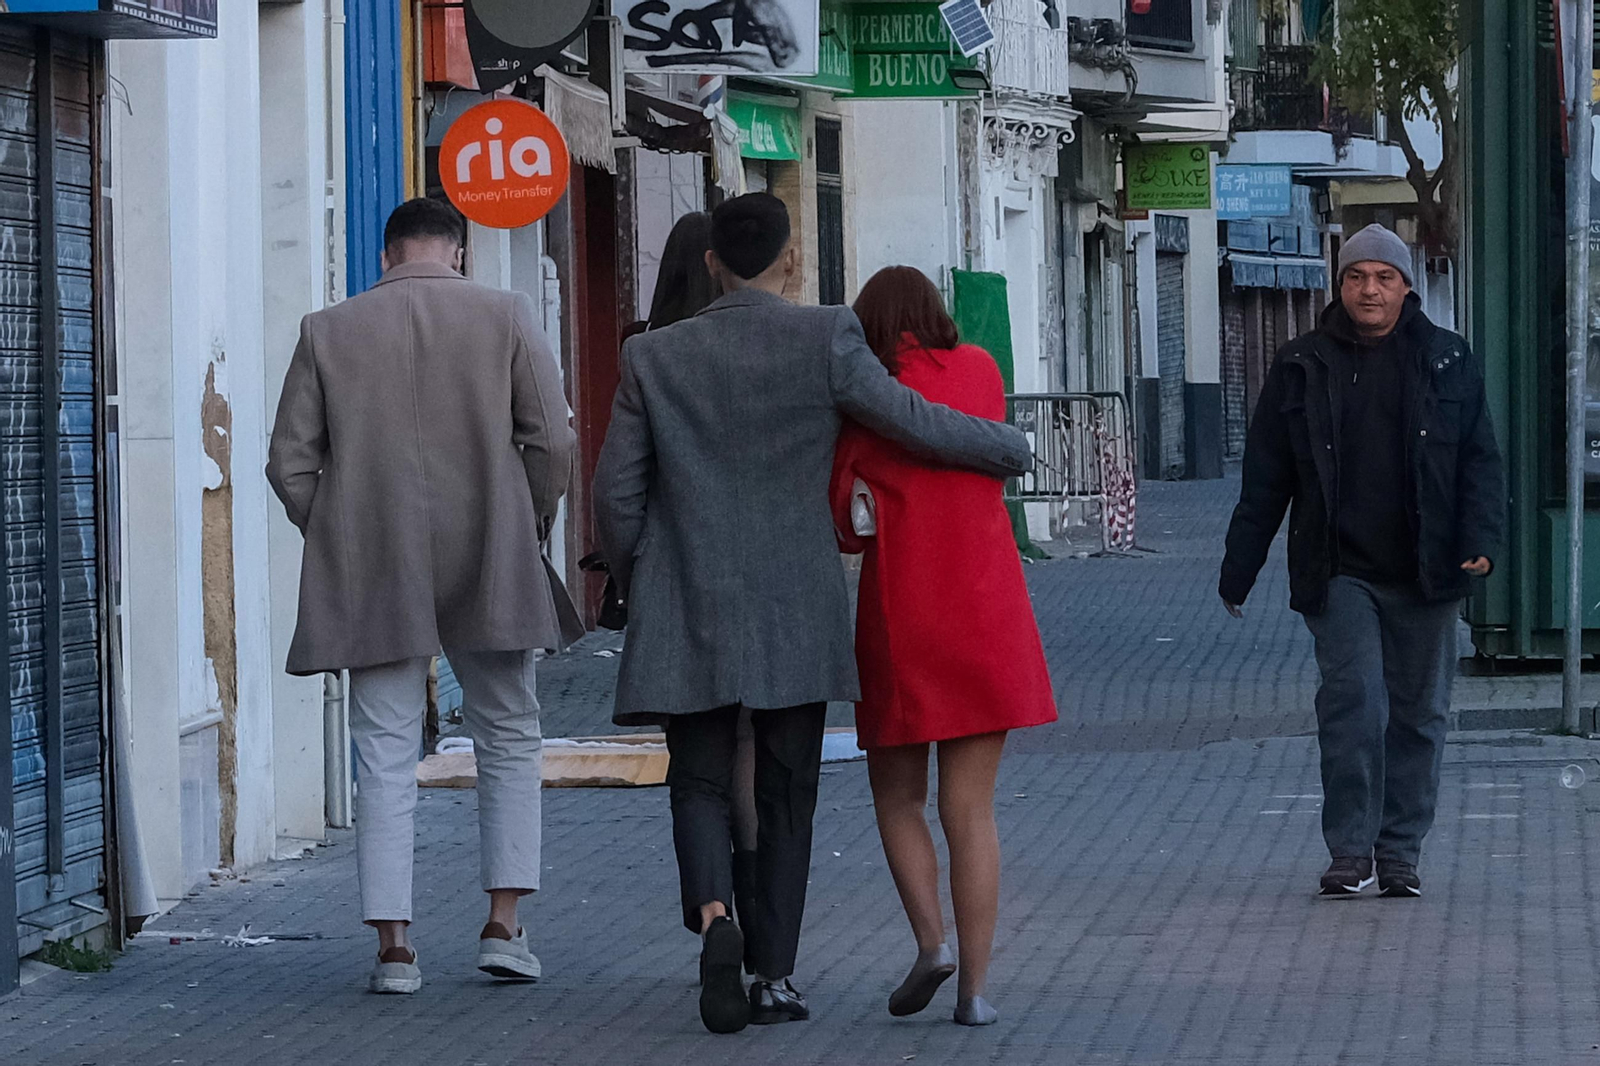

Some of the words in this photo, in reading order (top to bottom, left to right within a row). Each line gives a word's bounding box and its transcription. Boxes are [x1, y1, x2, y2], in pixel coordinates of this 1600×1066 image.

[869, 53, 946, 87] BUENO
[455, 117, 553, 183] ria
[458, 190, 501, 202] Money
[502, 184, 554, 199] Transfer
